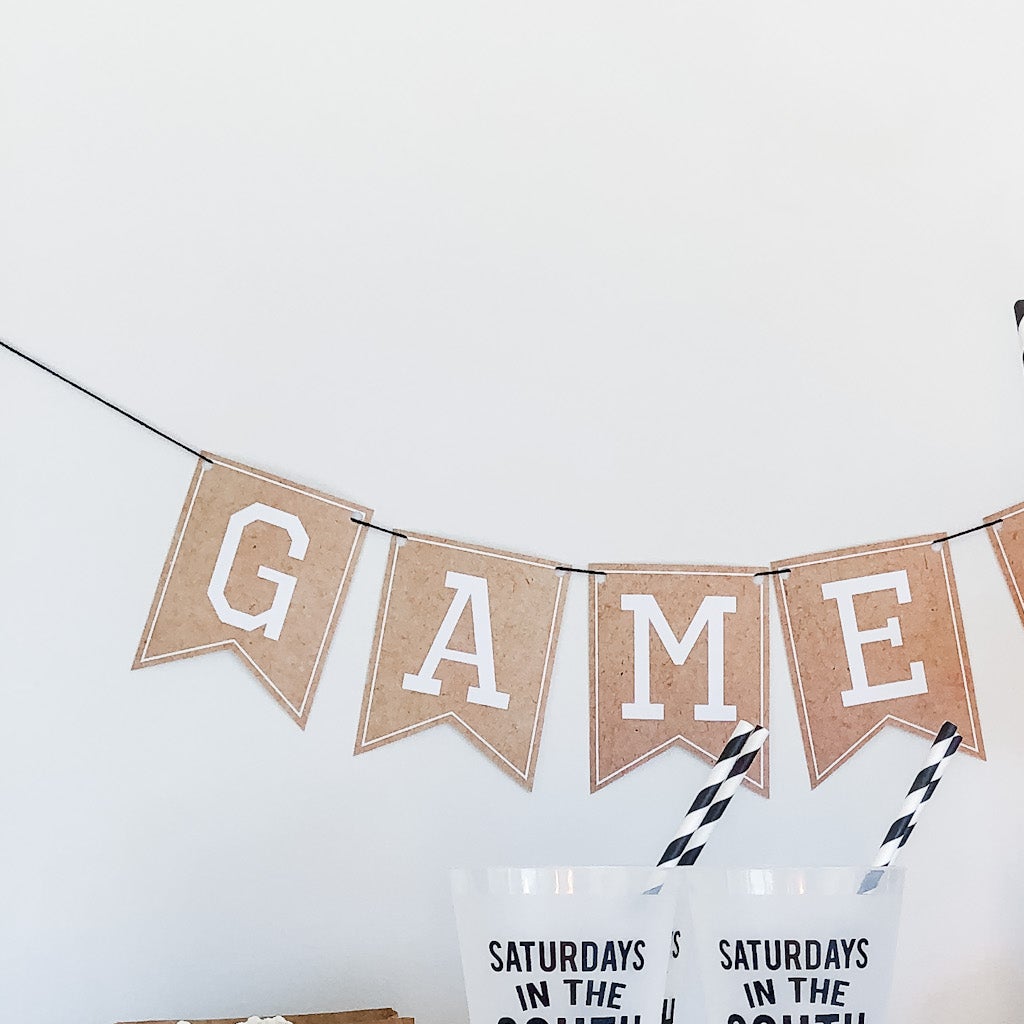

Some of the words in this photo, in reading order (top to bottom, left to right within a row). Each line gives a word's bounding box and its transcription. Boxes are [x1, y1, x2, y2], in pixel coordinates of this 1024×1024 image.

[489, 939, 646, 973] SATURDAYS
[719, 938, 870, 971] SATURDAYS
[516, 980, 550, 1011] IN
[563, 979, 627, 1010] THE
[743, 978, 776, 1008] IN
[788, 977, 851, 1008] THE
